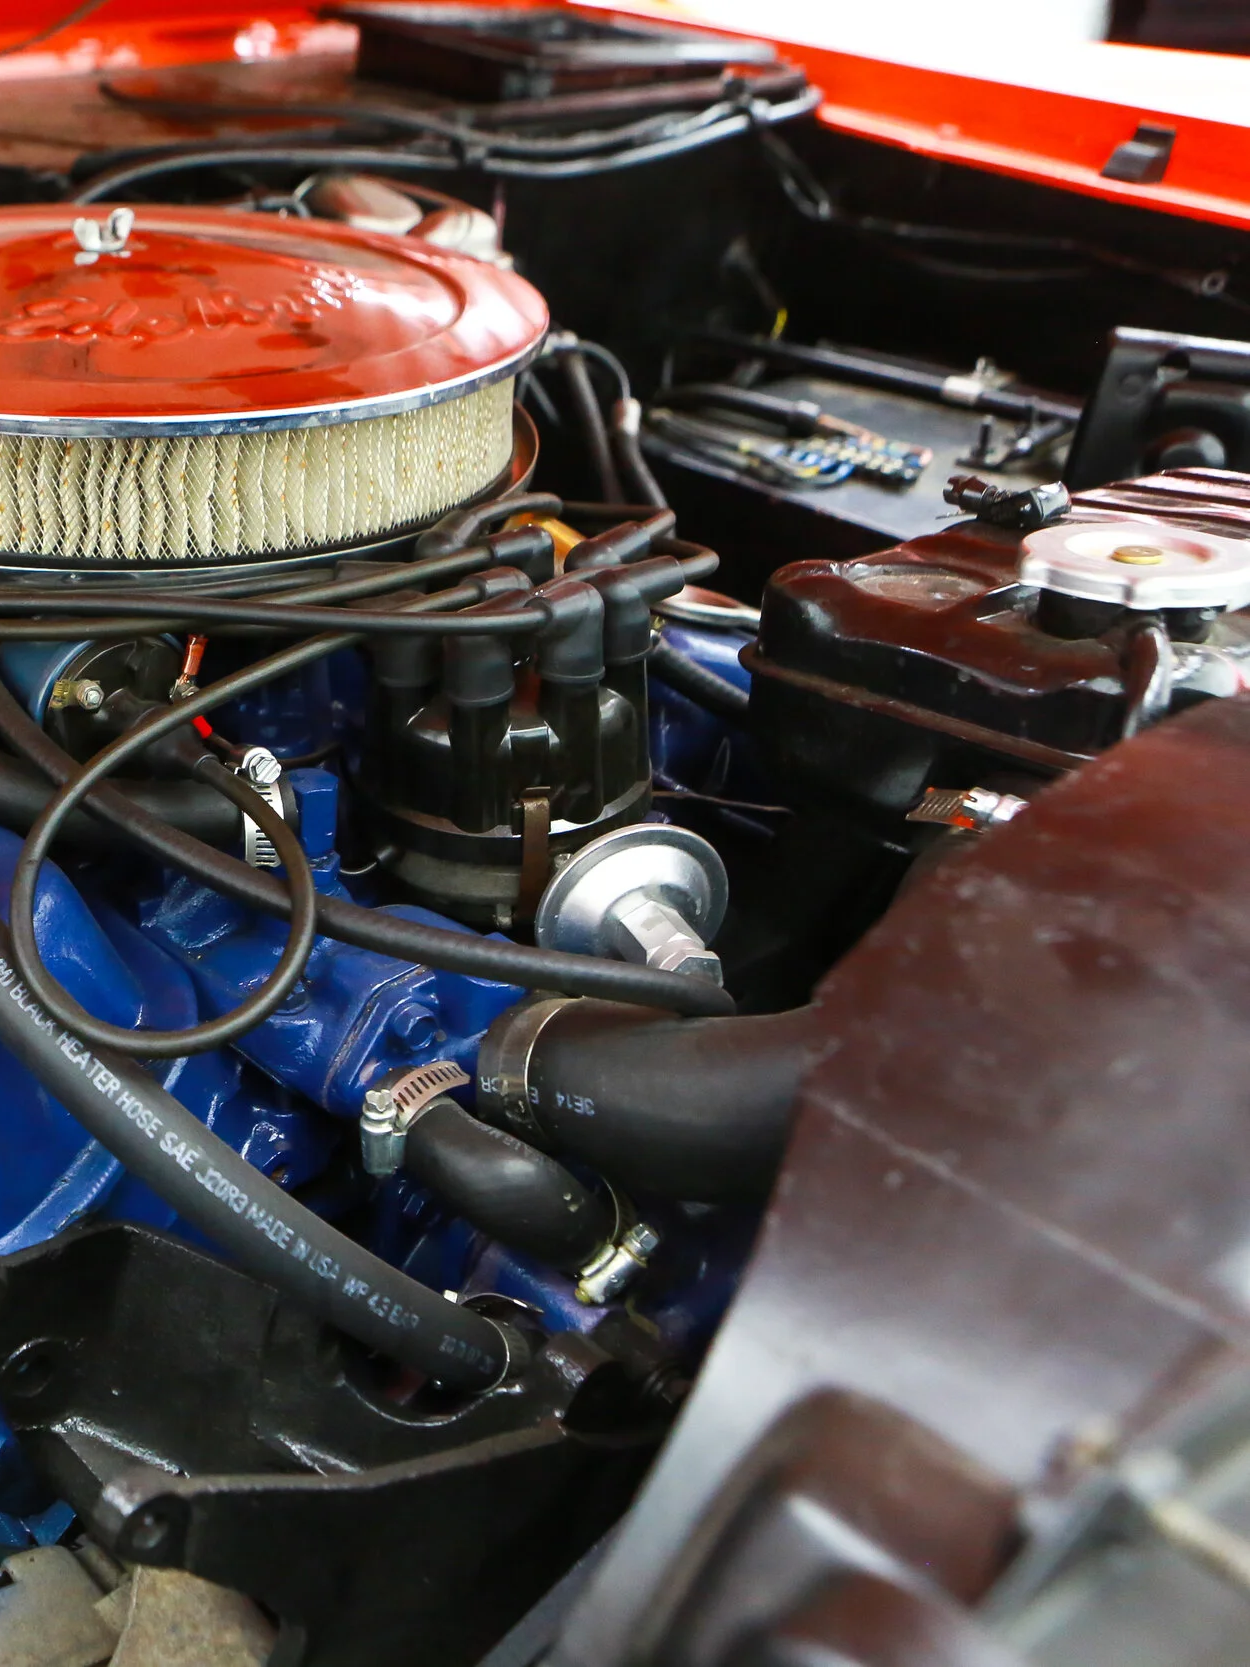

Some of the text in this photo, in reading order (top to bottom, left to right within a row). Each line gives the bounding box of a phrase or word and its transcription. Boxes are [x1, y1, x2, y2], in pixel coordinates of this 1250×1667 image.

[55, 1031, 122, 1098] HEATER
[115, 1091, 164, 1139] HOSE
[159, 1131, 200, 1172] SAE
[194, 1166, 250, 1214] J20R3
[244, 1202, 295, 1250] MADE
[290, 1237, 312, 1262] IN
[307, 1250, 342, 1280] USA
